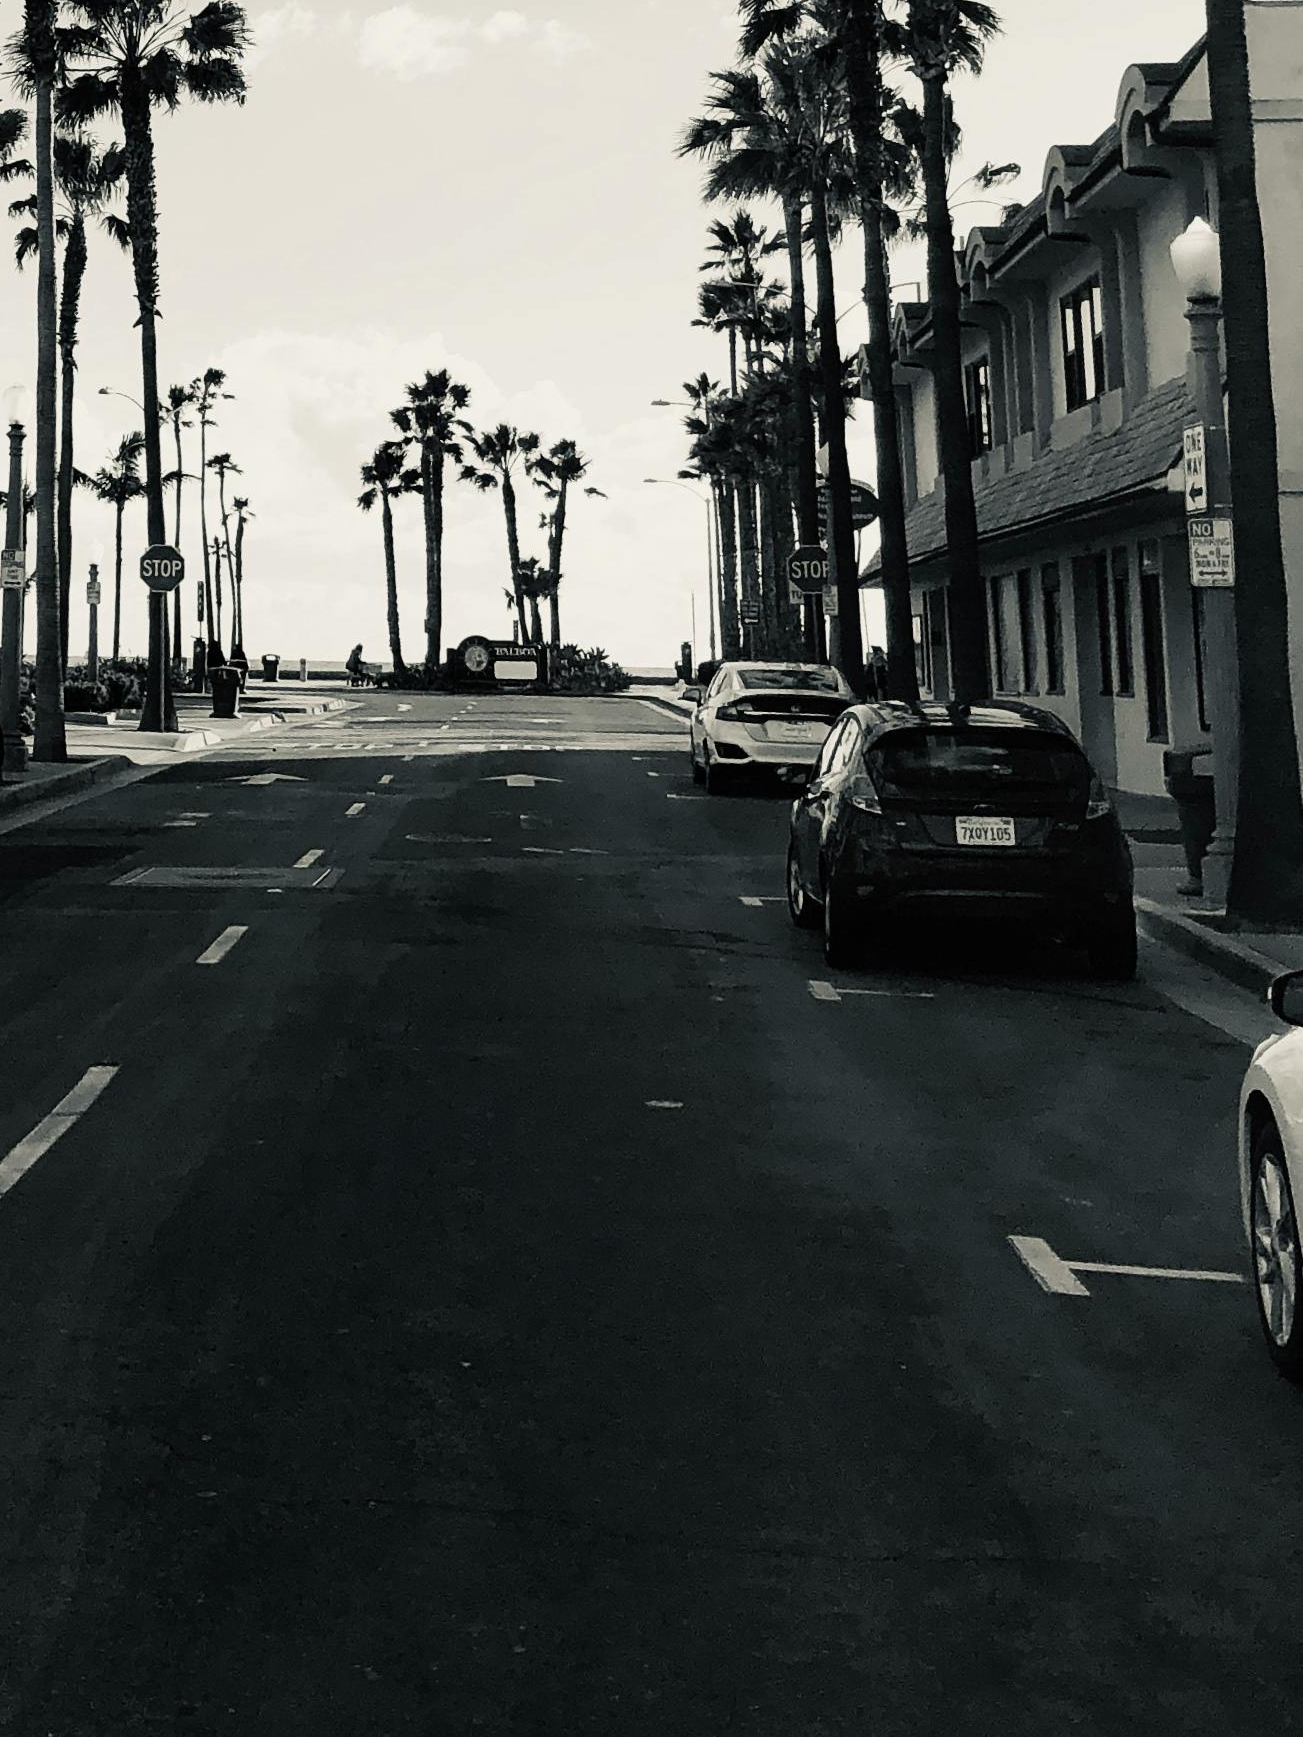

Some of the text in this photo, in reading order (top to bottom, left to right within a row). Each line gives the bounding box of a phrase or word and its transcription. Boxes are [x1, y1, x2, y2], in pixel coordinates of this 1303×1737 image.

[1186, 431, 1202, 454] ONE
[1186, 455, 1203, 476] WAY
[1192, 523, 1211, 536] NO
[142, 559, 182, 578] STOP
[791, 560, 830, 579] STOP
[494, 647, 537, 656] BALBOA
